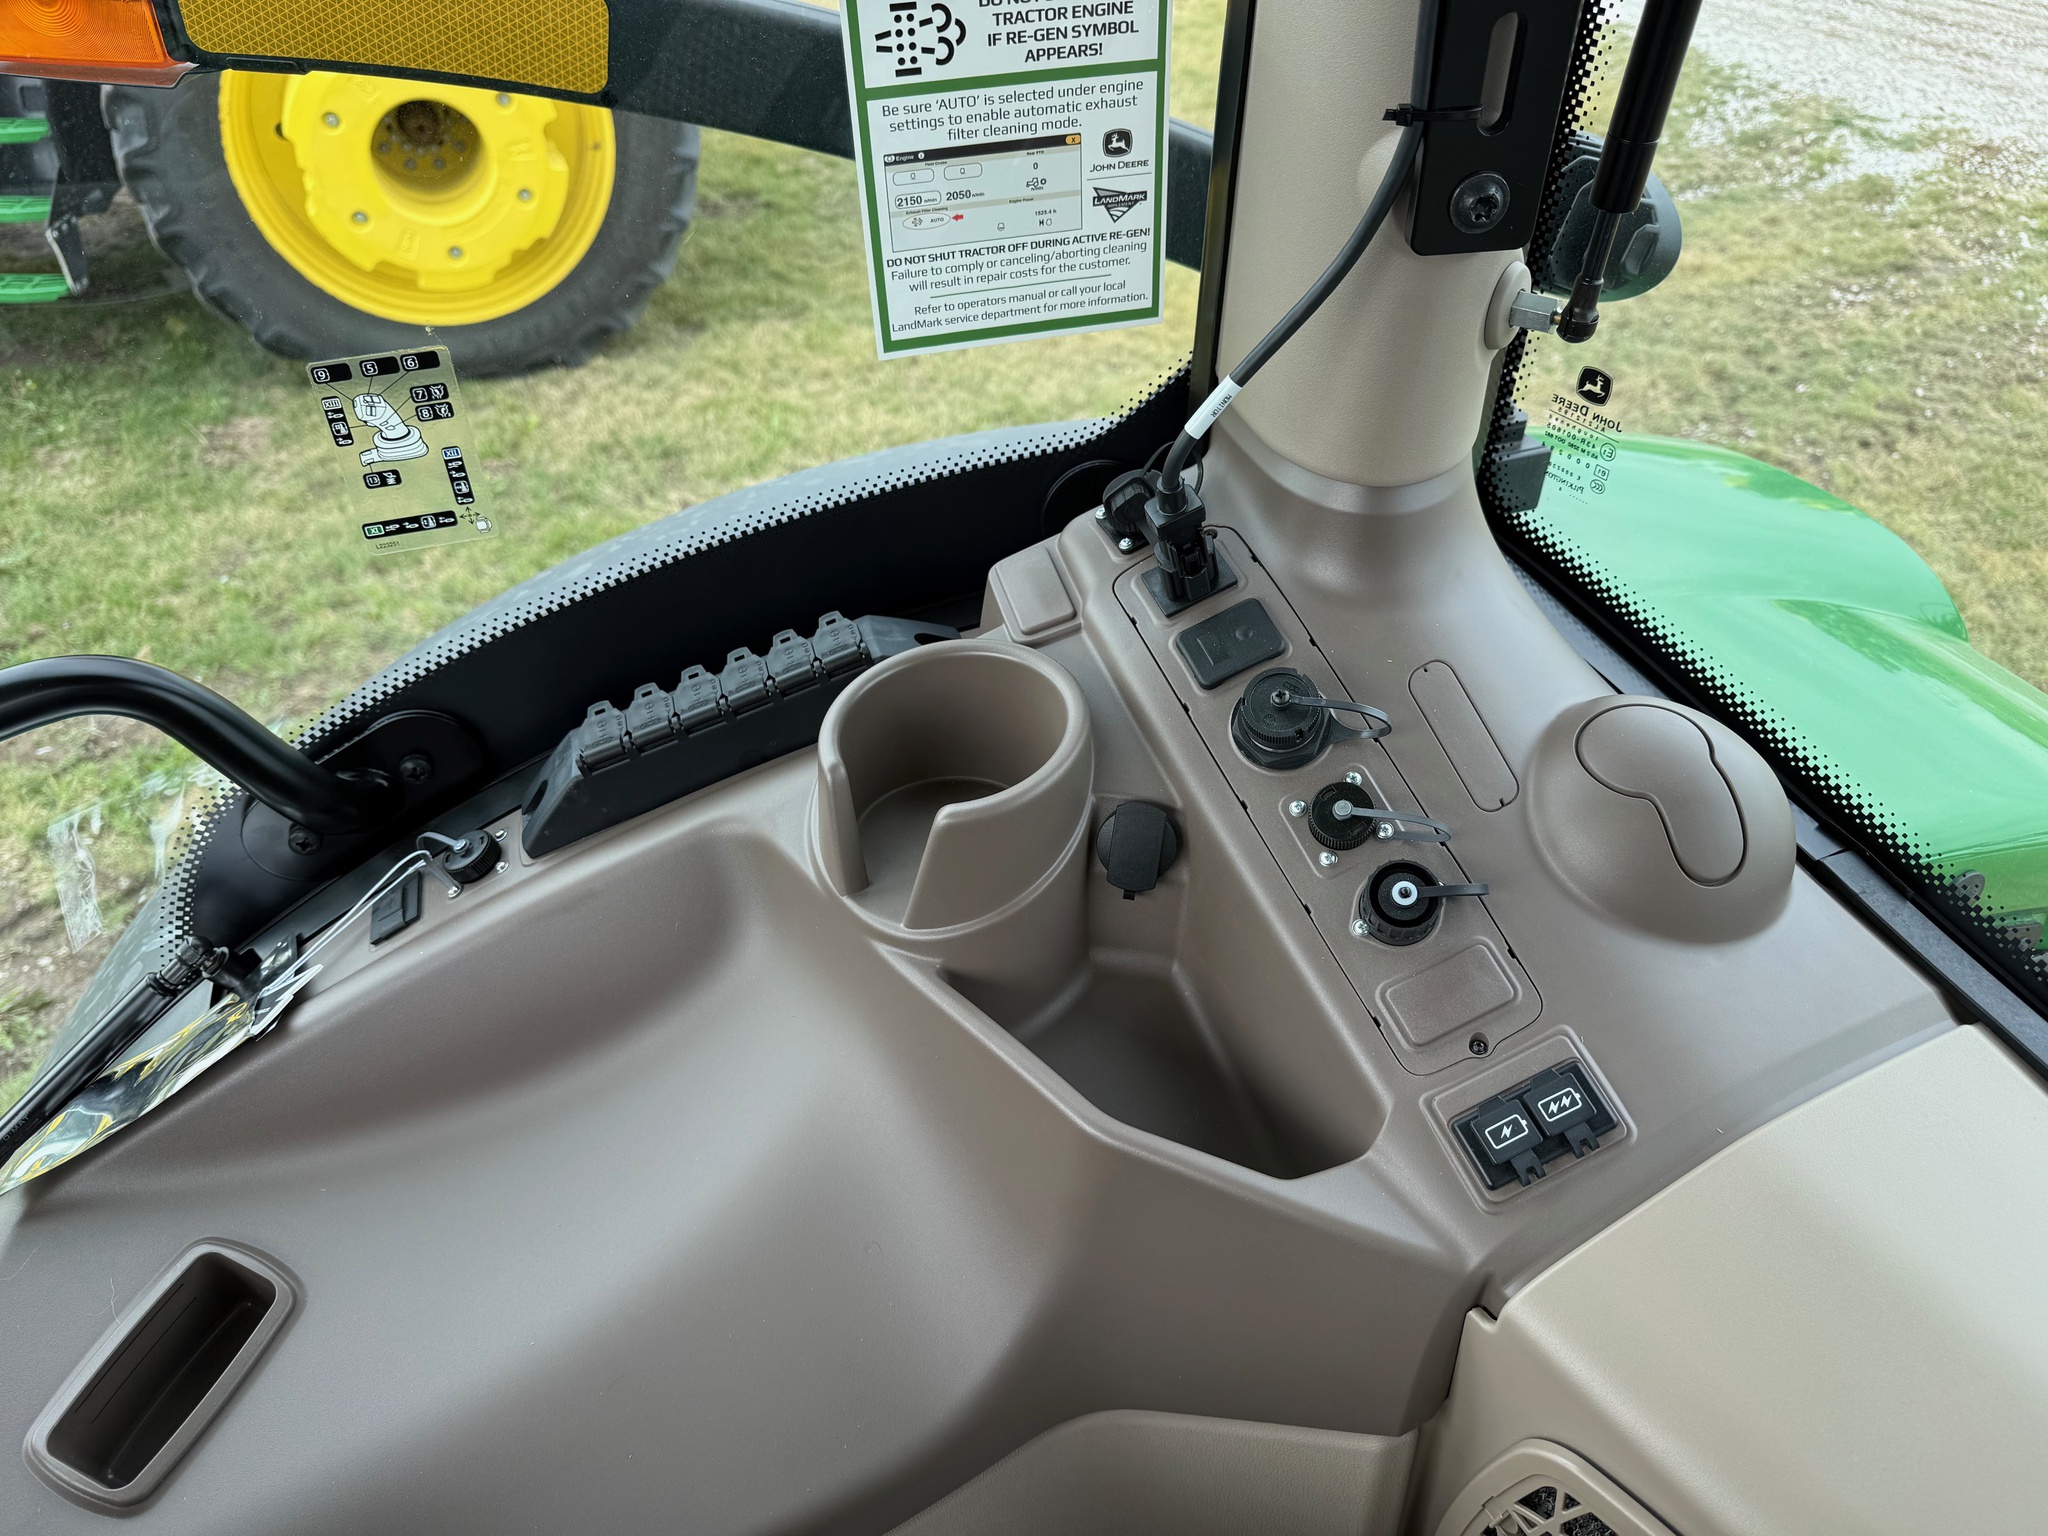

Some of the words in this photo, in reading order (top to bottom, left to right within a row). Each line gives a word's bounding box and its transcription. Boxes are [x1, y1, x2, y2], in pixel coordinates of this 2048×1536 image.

[992, 7, 1068, 26] TRACTOR
[1072, 0, 1134, 19] ENGINE
[988, 33, 1002, 46] IF
[1006, 26, 1068, 45] RE-GEN
[1072, 20, 1139, 38] SYMBOL
[1024, 43, 1103, 62] APPEARS!
[882, 105, 899, 117] Be
[903, 102, 932, 115] sure
[984, 94, 995, 106] is
[998, 87, 1054, 104] selected
[1058, 84, 1096, 98] under
[1100, 80, 1144, 95] engine
[890, 118, 944, 132] settings
[948, 114, 962, 126] to
[966, 108, 1010, 123] enable
[1014, 101, 1082, 118] automatic
[1085, 95, 1138, 111] exhaust
[947, 128, 980, 141] filter
[983, 122, 1038, 137] cleaning
[1042, 116, 1082, 130] mode.
[1090, 164, 1116, 173] JOHN
[1118, 160, 1149, 170] DEERE
[897, 195, 923, 207] 2150
[946, 190, 971, 201] 2050
[887, 258, 902, 268] DO
[905, 255, 926, 265] NOT
[928, 251, 956, 262] SHUT
[958, 245, 1006, 258] TRACTOR
[1008, 242, 1028, 252] OFF
[1031, 237, 1070, 250] DURING
[1072, 232, 1107, 244] ACTIVE
[1110, 228, 1150, 240] RE-GEN!
[892, 269, 928, 280] Failure
[931, 267, 942, 276] to
[945, 260, 984, 273] comply
[987, 260, 998, 269] or
[1000, 247, 1100, 267] canceling/aborting
[1103, 242, 1147, 254] cleaning
[909, 280, 928, 292] will
[930, 277, 961, 289] result
[964, 276, 973, 285] in
[976, 271, 1007, 284] repair
[1010, 268, 1038, 279] costs
[1041, 265, 1056, 275] for
[1059, 263, 1076, 273] the
[1079, 257, 1130, 270] customer.
[914, 305, 942, 315] Refer
[944, 303, 955, 312] to
[958, 296, 1006, 310] operators
[1009, 290, 1046, 303] manual
[1048, 290, 1059, 298] or
[1061, 286, 1077, 296] call
[1080, 285, 1101, 296] your
[1103, 280, 1126, 292] local
[892, 317, 942, 332] LandMark
[945, 314, 979, 325] service
[981, 305, 1041, 320] department
[1043, 303, 1058, 312] for
[1060, 300, 1085, 310] more
[1088, 293, 1148, 306] information.
[367, 364, 374, 373] 5
[407, 358, 414, 368] 6
[319, 371, 326, 380] 9
[324, 400, 341, 408] XIII
[416, 390, 424, 399] 7
[422, 409, 429, 418] 8
